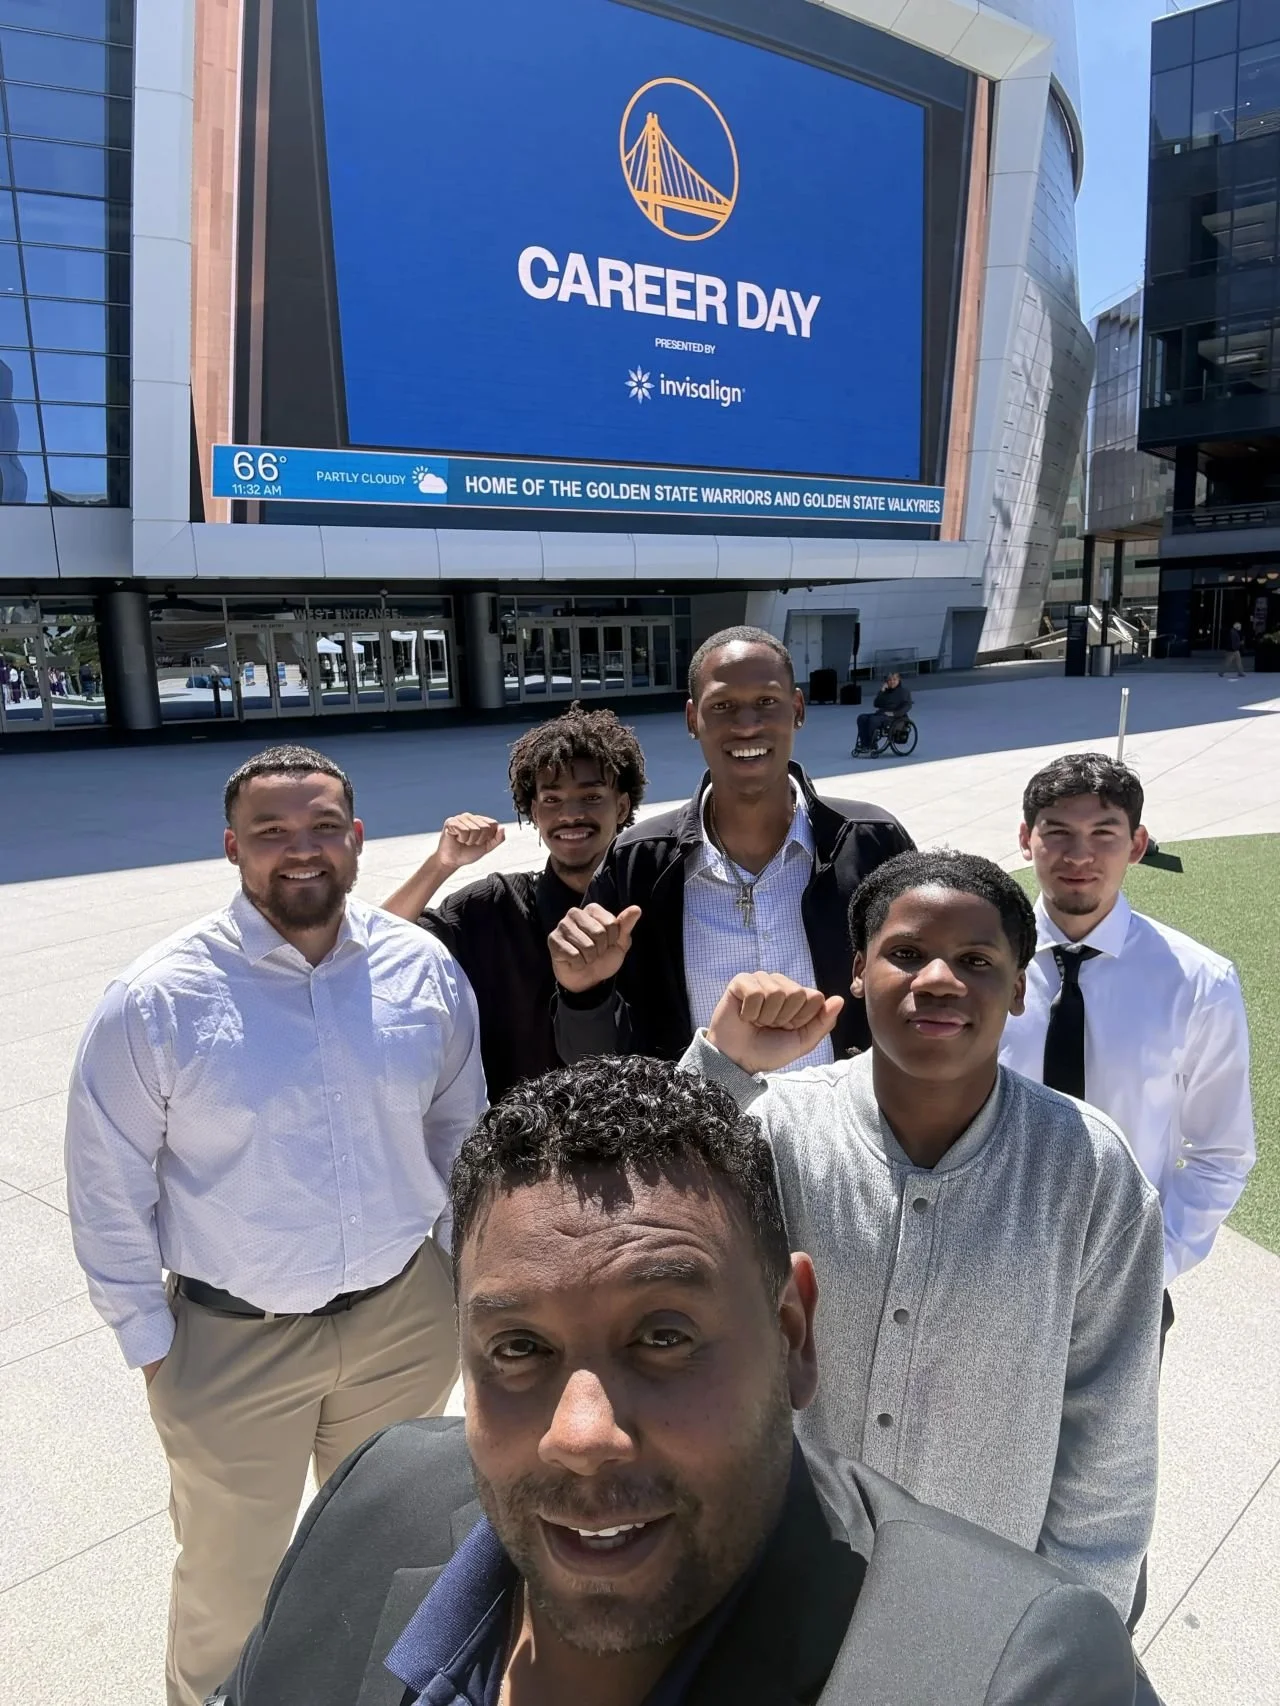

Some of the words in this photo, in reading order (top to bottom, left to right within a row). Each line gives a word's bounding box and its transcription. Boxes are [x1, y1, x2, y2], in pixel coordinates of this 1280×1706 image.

[518, 246, 728, 325] CAREER
[737, 281, 821, 338] DAY
[655, 337, 704, 353] PRESENTED
[704, 344, 716, 354] BY
[660, 373, 742, 407] invisalign
[233, 451, 287, 482] 66°
[316, 471, 359, 484] PARTLY
[361, 473, 406, 486] CLOUDY
[232, 484, 261, 495] 11:32
[263, 485, 282, 496] AM
[465, 475, 518, 495] HOME
[522, 478, 545, 496] OF
[549, 480, 582, 498] THE
[586, 481, 650, 501] GOLDEN
[654, 485, 698, 503] STATE
[701, 487, 772, 506] WARRIORS
[774, 491, 800, 507] AND
[803, 492, 851, 509] GOLDEN
[853, 496, 885, 511] STATE
[888, 498, 940, 514] VALKYRIES
[293, 608, 332, 620] WEST
